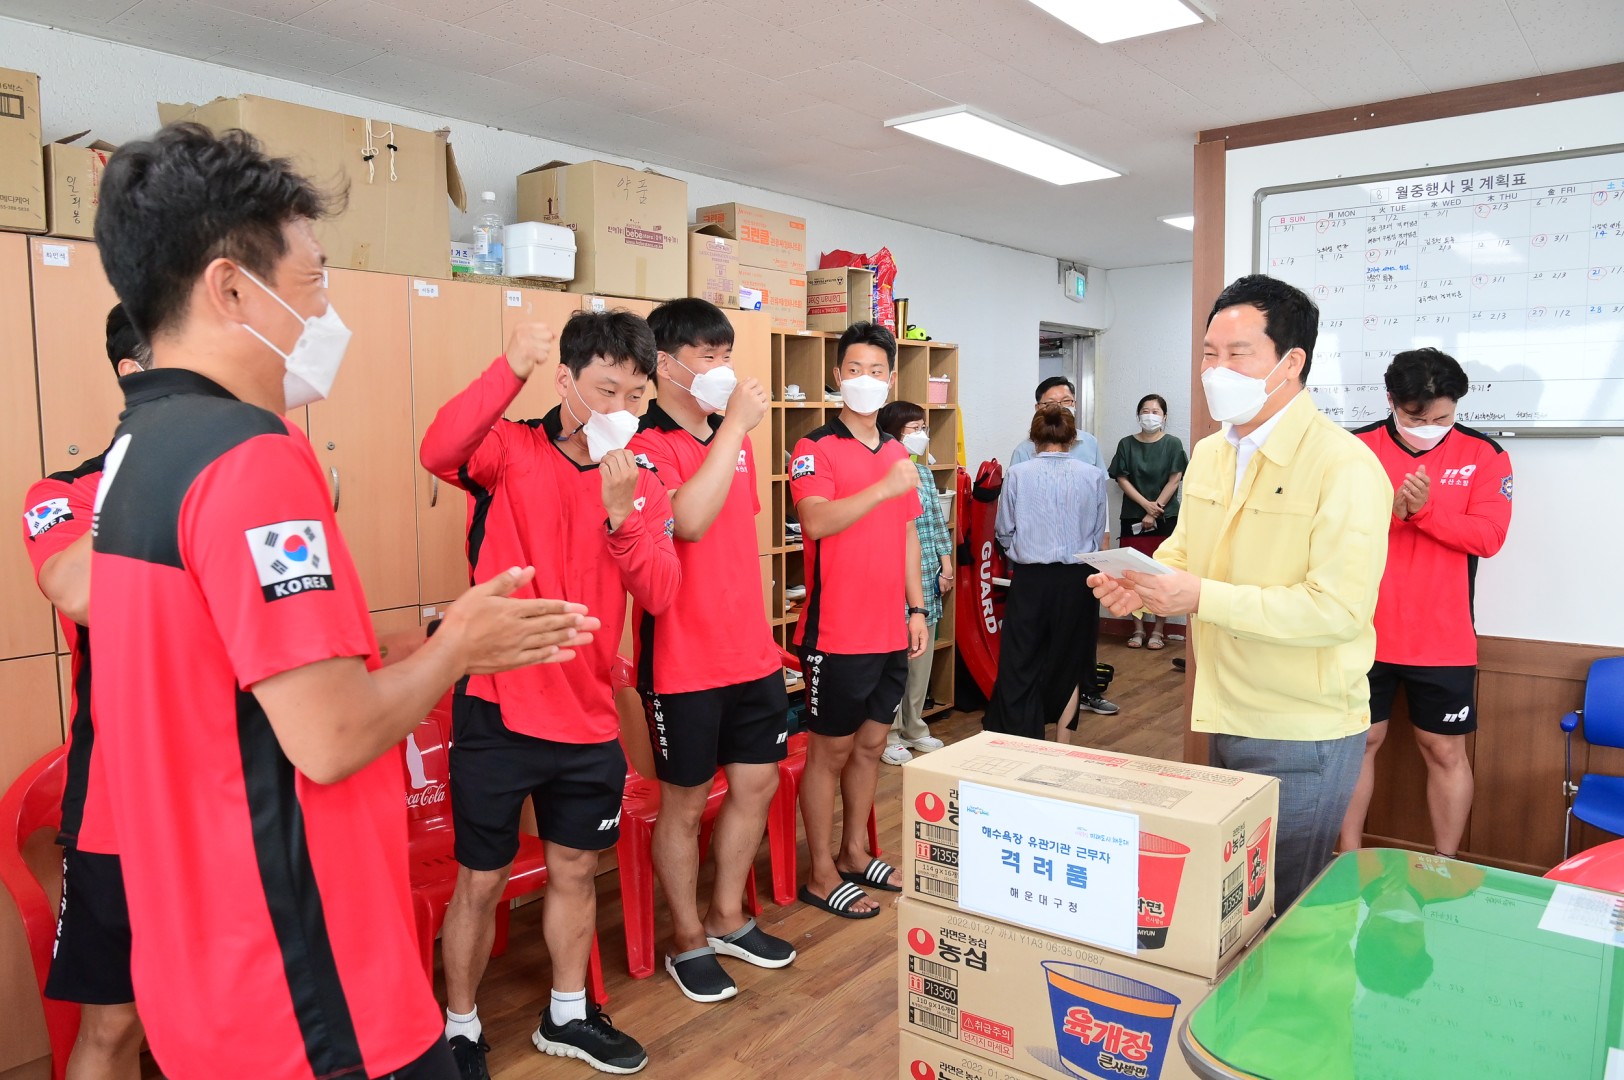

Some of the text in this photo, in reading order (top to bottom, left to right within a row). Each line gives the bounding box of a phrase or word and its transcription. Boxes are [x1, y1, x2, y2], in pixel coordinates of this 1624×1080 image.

[1395, 173, 1528, 200] 월중행사 및 계획표
[1500, 192, 1518, 200] THU
[1561, 186, 1576, 194] FRI
[1443, 198, 1462, 206] WED
[1289, 216, 1306, 224] SUN
[1338, 210, 1356, 218] MON
[741, 226, 770, 246] 크린클
[1442, 464, 1477, 480] 119
[274, 576, 328, 598] KOREA
[980, 541, 998, 634] GUARD
[1442, 706, 1470, 723] 119
[776, 732, 788, 745] 11
[982, 826, 1111, 864] 해수욕장 유관기관 근무자
[932, 847, 959, 865] 가355
[940, 927, 988, 950] 라면은 농심
[948, 916, 995, 936] 2022.01.27
[1020, 934, 1044, 950] Y1A3
[1047, 942, 1073, 958] 06:35
[1076, 950, 1105, 966] 00887
[938, 938, 988, 972] 농심
[925, 982, 957, 1002] 가3560
[974, 1020, 1010, 1042] 취급주의
[1064, 1006, 1153, 1062] 육개장
[964, 1032, 1012, 1055] 던지지 마세요
[940, 1062, 964, 1078] 라면은
[1098, 1053, 1148, 1077] 큰사발면
